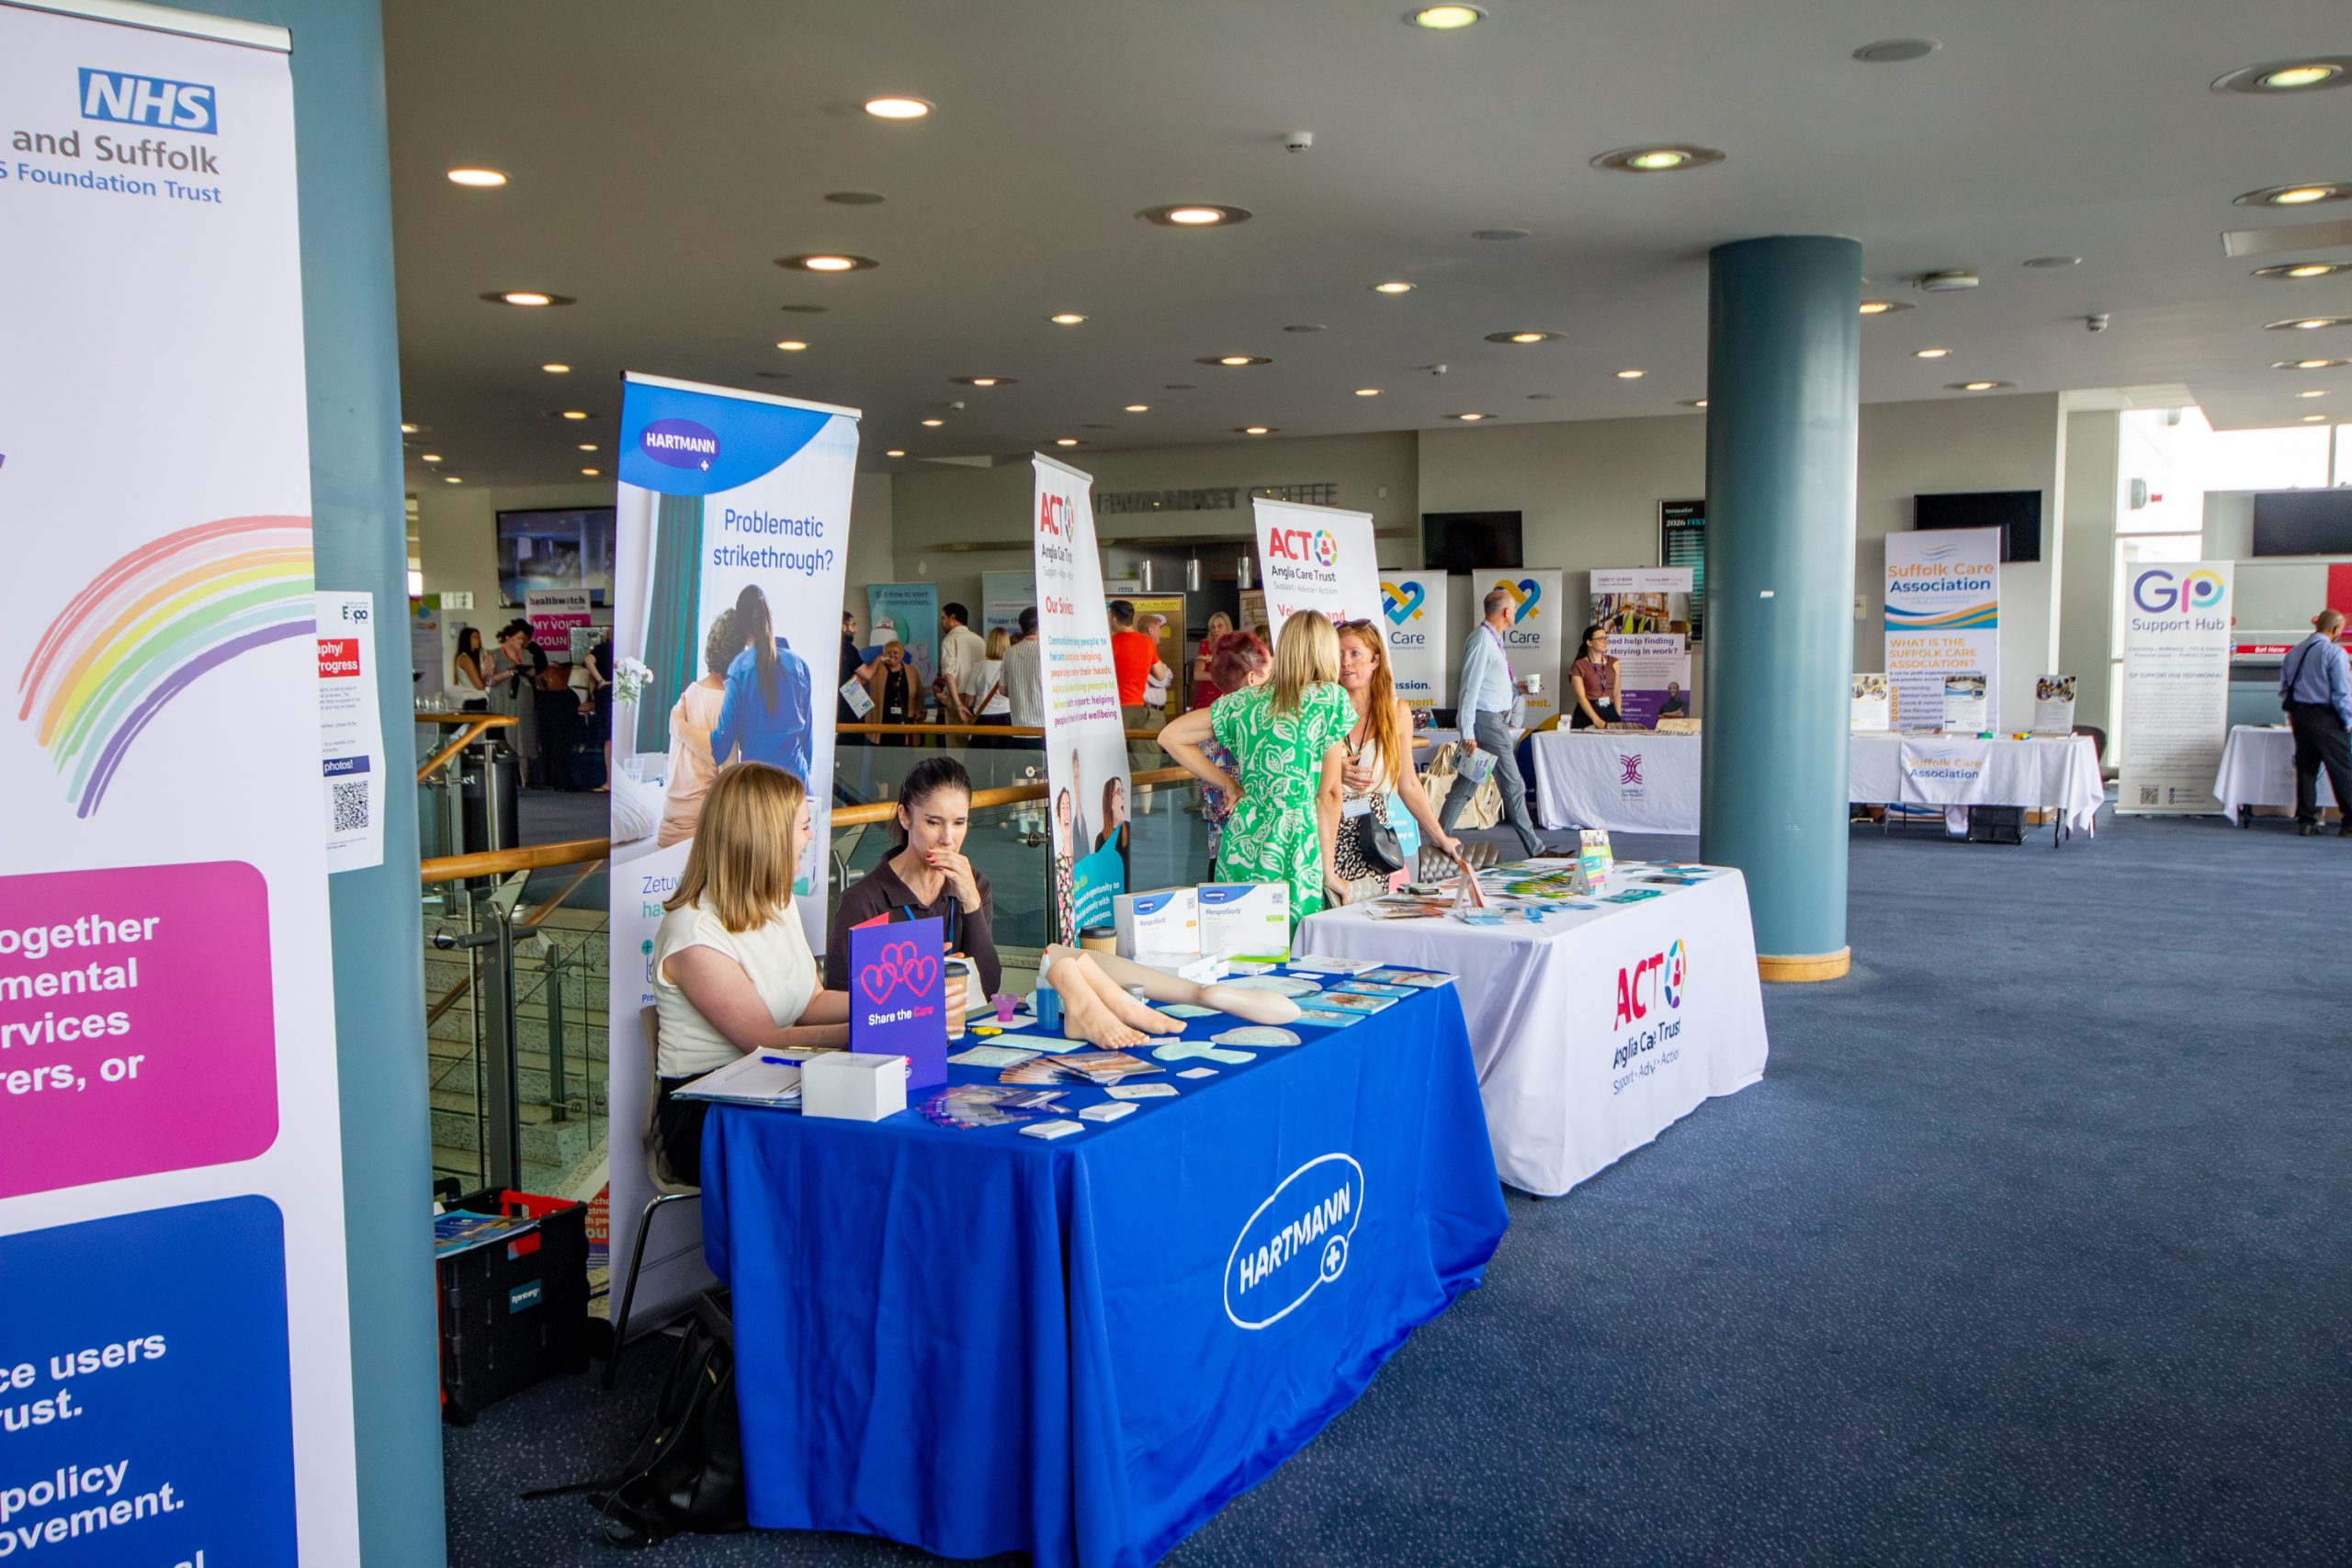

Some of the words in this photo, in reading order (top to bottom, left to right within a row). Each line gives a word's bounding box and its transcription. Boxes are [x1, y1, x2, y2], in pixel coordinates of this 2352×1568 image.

[84, 73, 211, 129] NHS
[12, 130, 80, 157] and
[95, 135, 220, 175] Suffolk
[17, 163, 156, 196] Foundation
[164, 181, 221, 203] Trust
[646, 433, 716, 454] HARTMANN
[724, 509, 824, 537] Problematic
[1040, 492, 1063, 536] ACT
[1666, 519, 1686, 527] 2026
[1270, 527, 1312, 561] ACT
[713, 544, 834, 577] strikethrough?
[1272, 565, 1295, 581] Anglia
[1295, 568, 1314, 580] Care
[1314, 570, 1336, 581] Trust
[1888, 563, 1948, 578] Suffolk
[1954, 562, 1995, 575] Care
[1890, 577, 1991, 592] Association
[2133, 570, 2224, 614] GP
[1046, 595, 1057, 615] Our
[1326, 609, 1345, 622] and
[534, 621, 548, 630] MY
[2132, 618, 2189, 633] Support
[2195, 617, 2224, 630] Hub
[1391, 631, 1425, 645] Care
[1510, 630, 1540, 644] Care
[1624, 637, 1643, 646] help
[1645, 637, 1674, 646] finding
[1890, 639, 1926, 648] WHAT
[1611, 648, 1641, 656] staying
[1890, 649, 1941, 659] SUFFOLK
[1945, 649, 1977, 657] CARE
[319, 660, 358, 674] rogress
[1890, 658, 1975, 669] ASSOCIATION?
[1091, 694, 1114, 706] helping
[1088, 709, 1117, 721] wellbeing
[324, 760, 353, 774] photos!
[1909, 757, 1950, 768] Suffolk
[1954, 759, 1982, 769] Care
[1910, 769, 1979, 779] Association
[1206, 908, 1241, 916] RespoSorb
[0, 915, 160, 959] ogether
[0, 957, 138, 1001] mental
[1614, 953, 1663, 1032] ACT
[868, 1012, 895, 1026] Share
[897, 1009, 912, 1020] the
[913, 1006, 934, 1017] Care
[1, 1010, 130, 1050] rvices
[100, 1055, 144, 1082] or
[1240, 1181, 1350, 1295] HARTMANN
[51, 1335, 165, 1381] users
[0, 1388, 82, 1432] ust.
[1, 1460, 128, 1523] policy
[0, 1482, 184, 1557] ovement.
